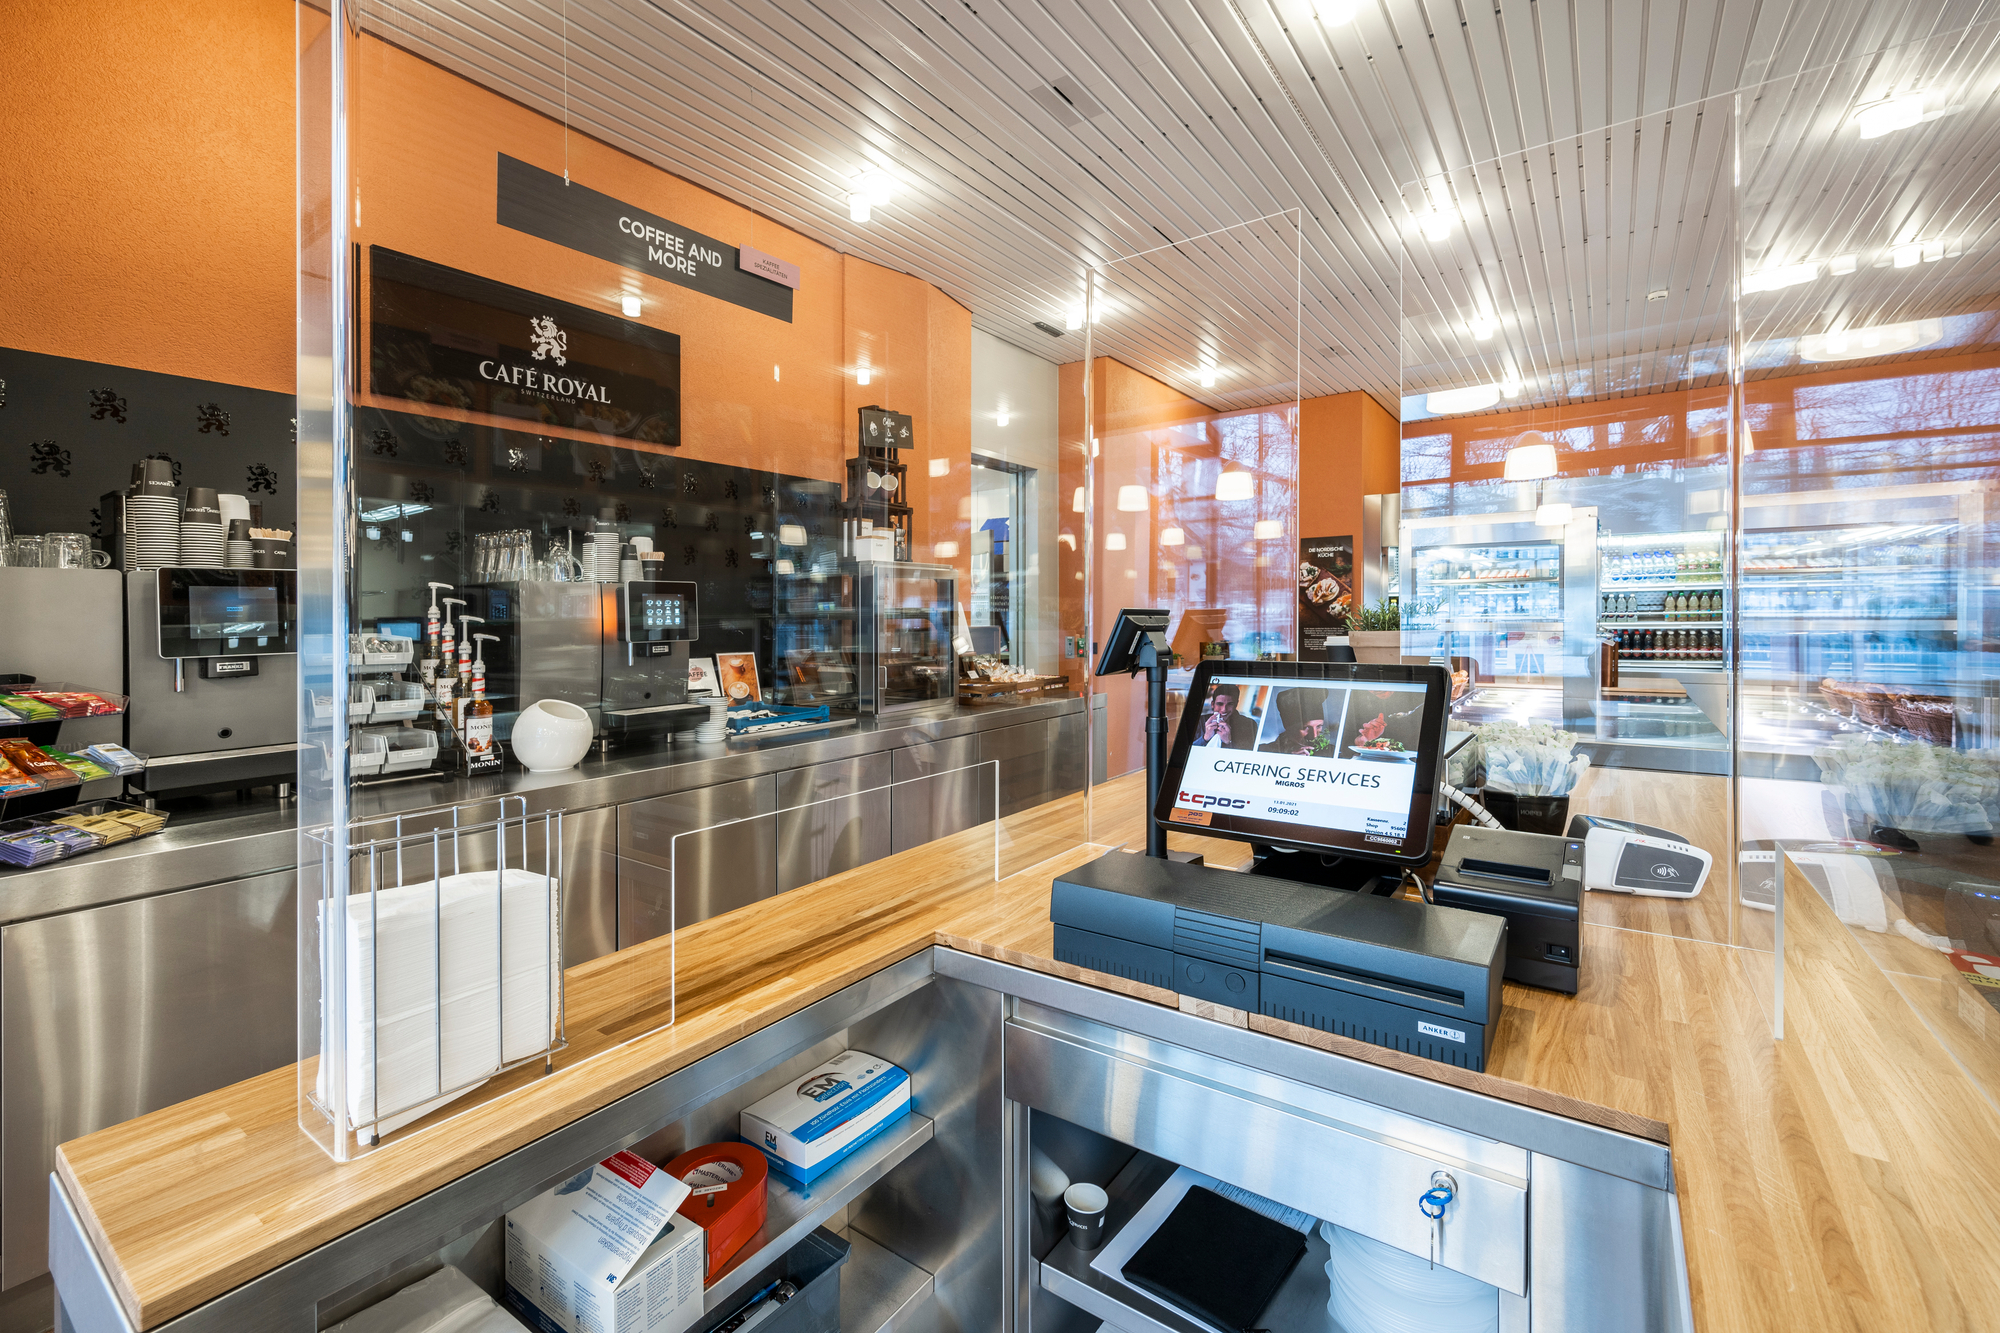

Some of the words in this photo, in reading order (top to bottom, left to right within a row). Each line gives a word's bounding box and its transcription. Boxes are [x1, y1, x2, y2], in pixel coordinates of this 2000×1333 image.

[619, 216, 684, 254] COFFEE
[688, 243, 722, 268] AND
[648, 245, 696, 276] MORE
[762, 258, 780, 270] KAFFEE
[753, 261, 788, 280] SPEZIALITÄTEN
[479, 360, 538, 389] CAFÉ
[542, 373, 611, 404] ROYAL
[520, 388, 576, 405] SWITZERLAND
[470, 758, 501, 769] MONIN
[1213, 759, 1291, 779] CATERING
[1296, 768, 1381, 788] SERVICES
[1275, 779, 1305, 789] MIGROS
[1267, 806, 1299, 817] 09:09:02
[1422, 1025, 1449, 1036] ANKER
[800, 1076, 842, 1099] EM
[765, 1131, 777, 1145] EM
[635, 1206, 663, 1227] Mascherine
[626, 1224, 648, 1246] Masques
[597, 1235, 634, 1265] Hygienemasken
[605, 1272, 618, 1284] 3M
